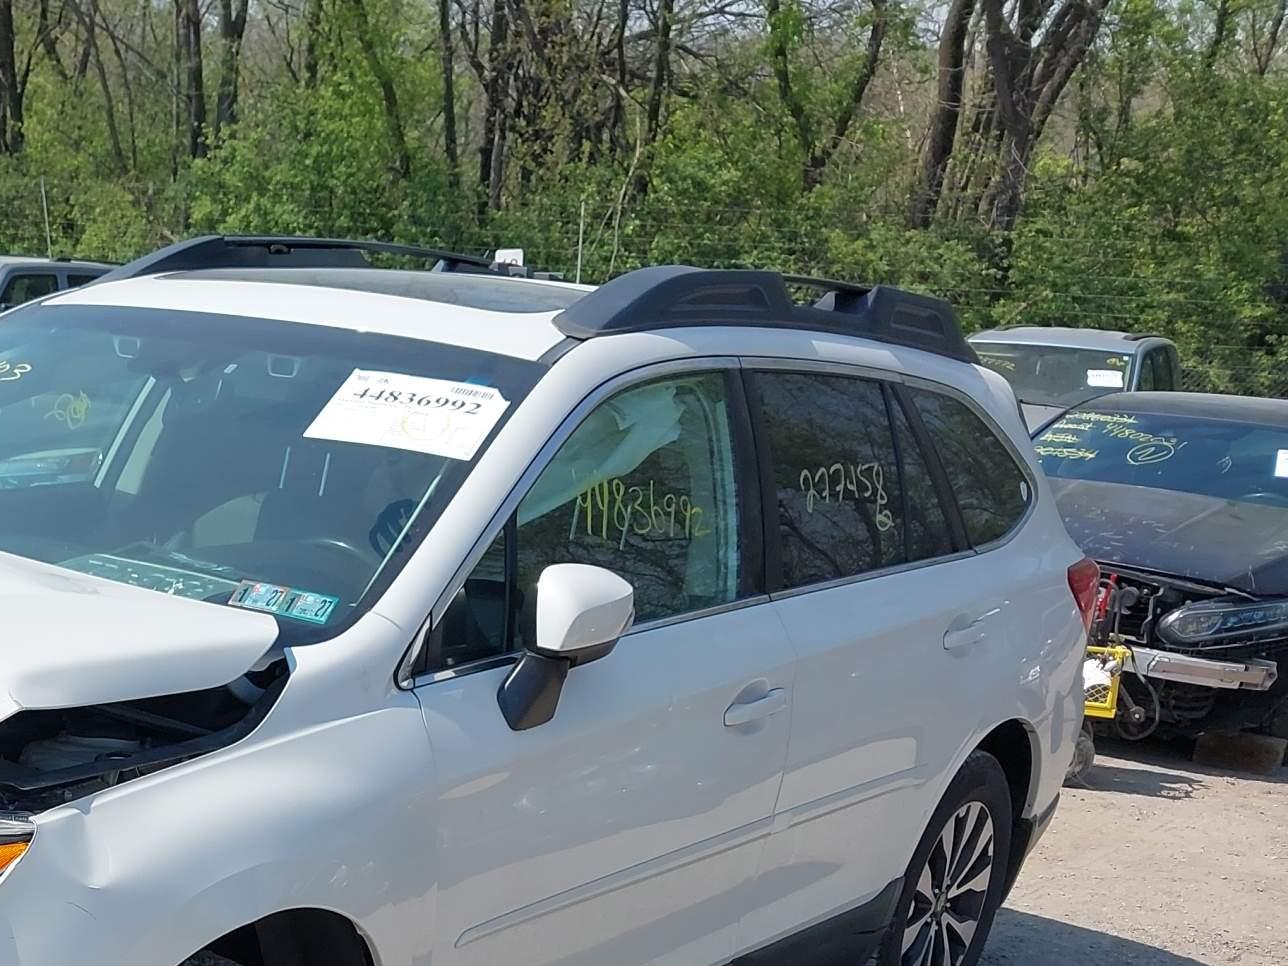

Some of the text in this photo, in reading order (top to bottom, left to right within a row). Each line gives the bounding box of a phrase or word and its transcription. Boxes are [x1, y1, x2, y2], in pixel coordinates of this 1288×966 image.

[353, 387, 482, 416] 44836992
[266, 590, 284, 608] 27
[315, 600, 333, 618] 27
